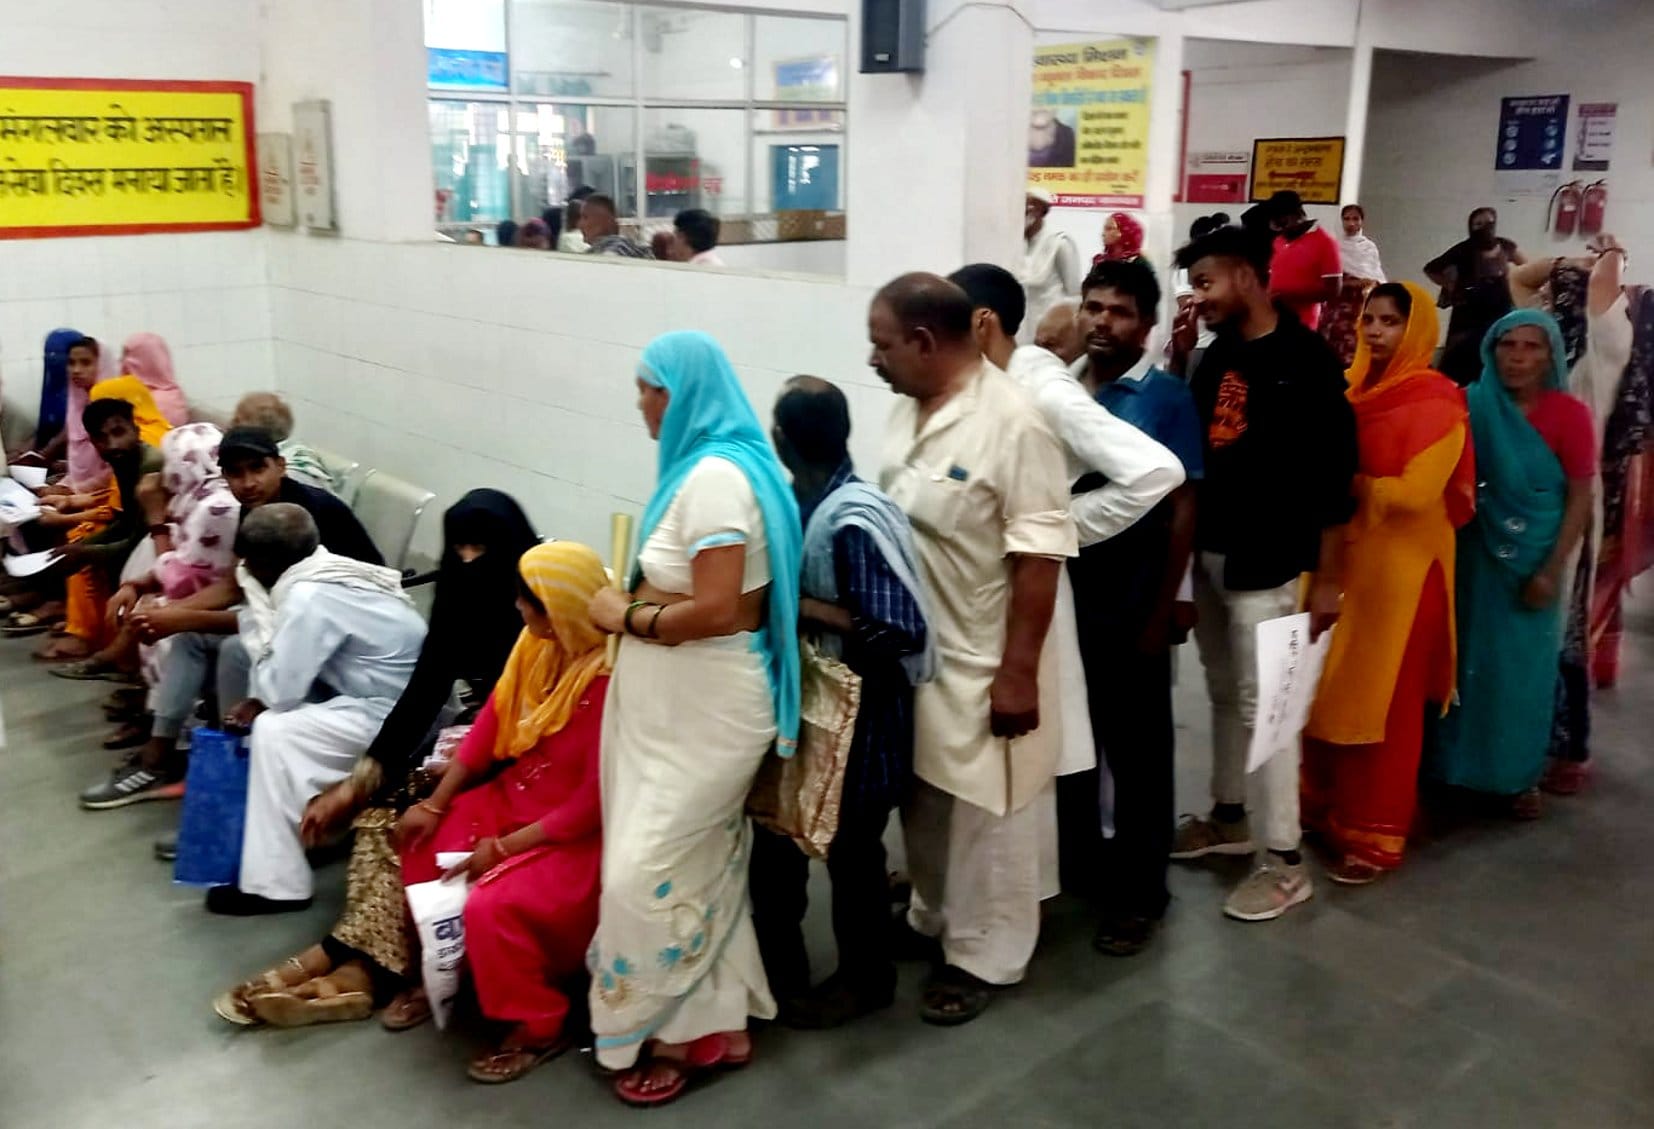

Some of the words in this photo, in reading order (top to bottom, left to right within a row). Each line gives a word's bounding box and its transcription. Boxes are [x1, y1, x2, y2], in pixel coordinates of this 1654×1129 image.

[103, 103, 137, 143] को
[48, 157, 107, 197] दिवस
[111, 166, 170, 193] मनाया
[172, 166, 216, 193] जाता
[211, 157, 236, 198] है
